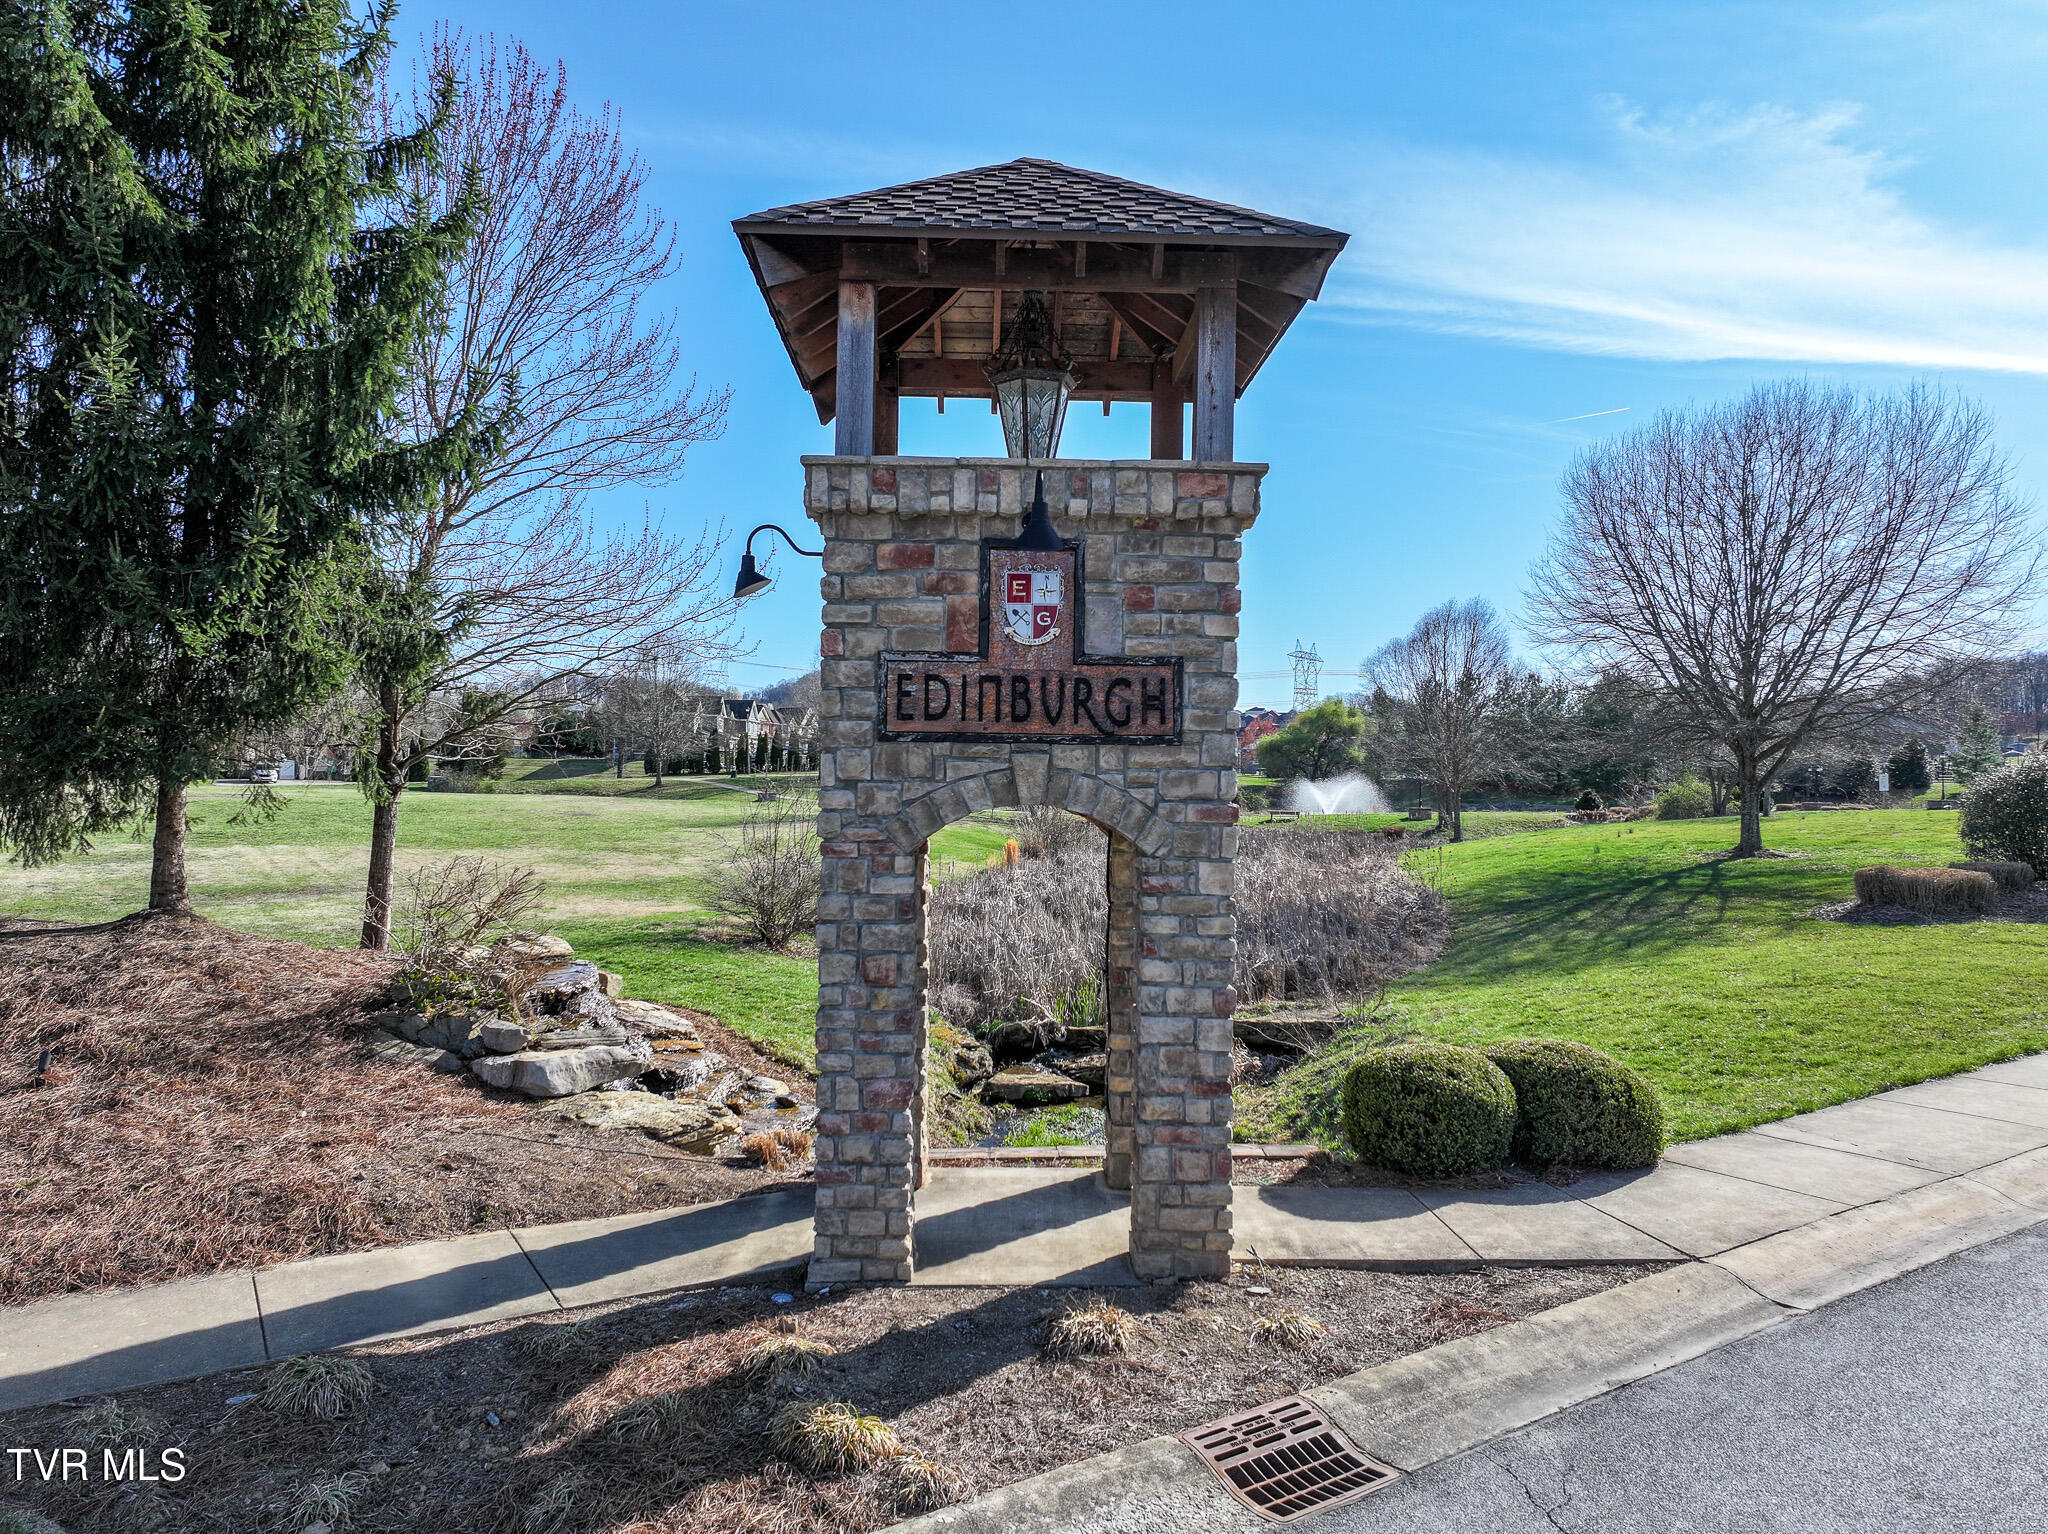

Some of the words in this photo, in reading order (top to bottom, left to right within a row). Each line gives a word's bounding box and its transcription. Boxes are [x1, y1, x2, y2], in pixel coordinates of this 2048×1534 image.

[1012, 580, 1026, 596] E
[1036, 611, 1052, 626] G
[896, 673, 1166, 736] EDINBURGH
